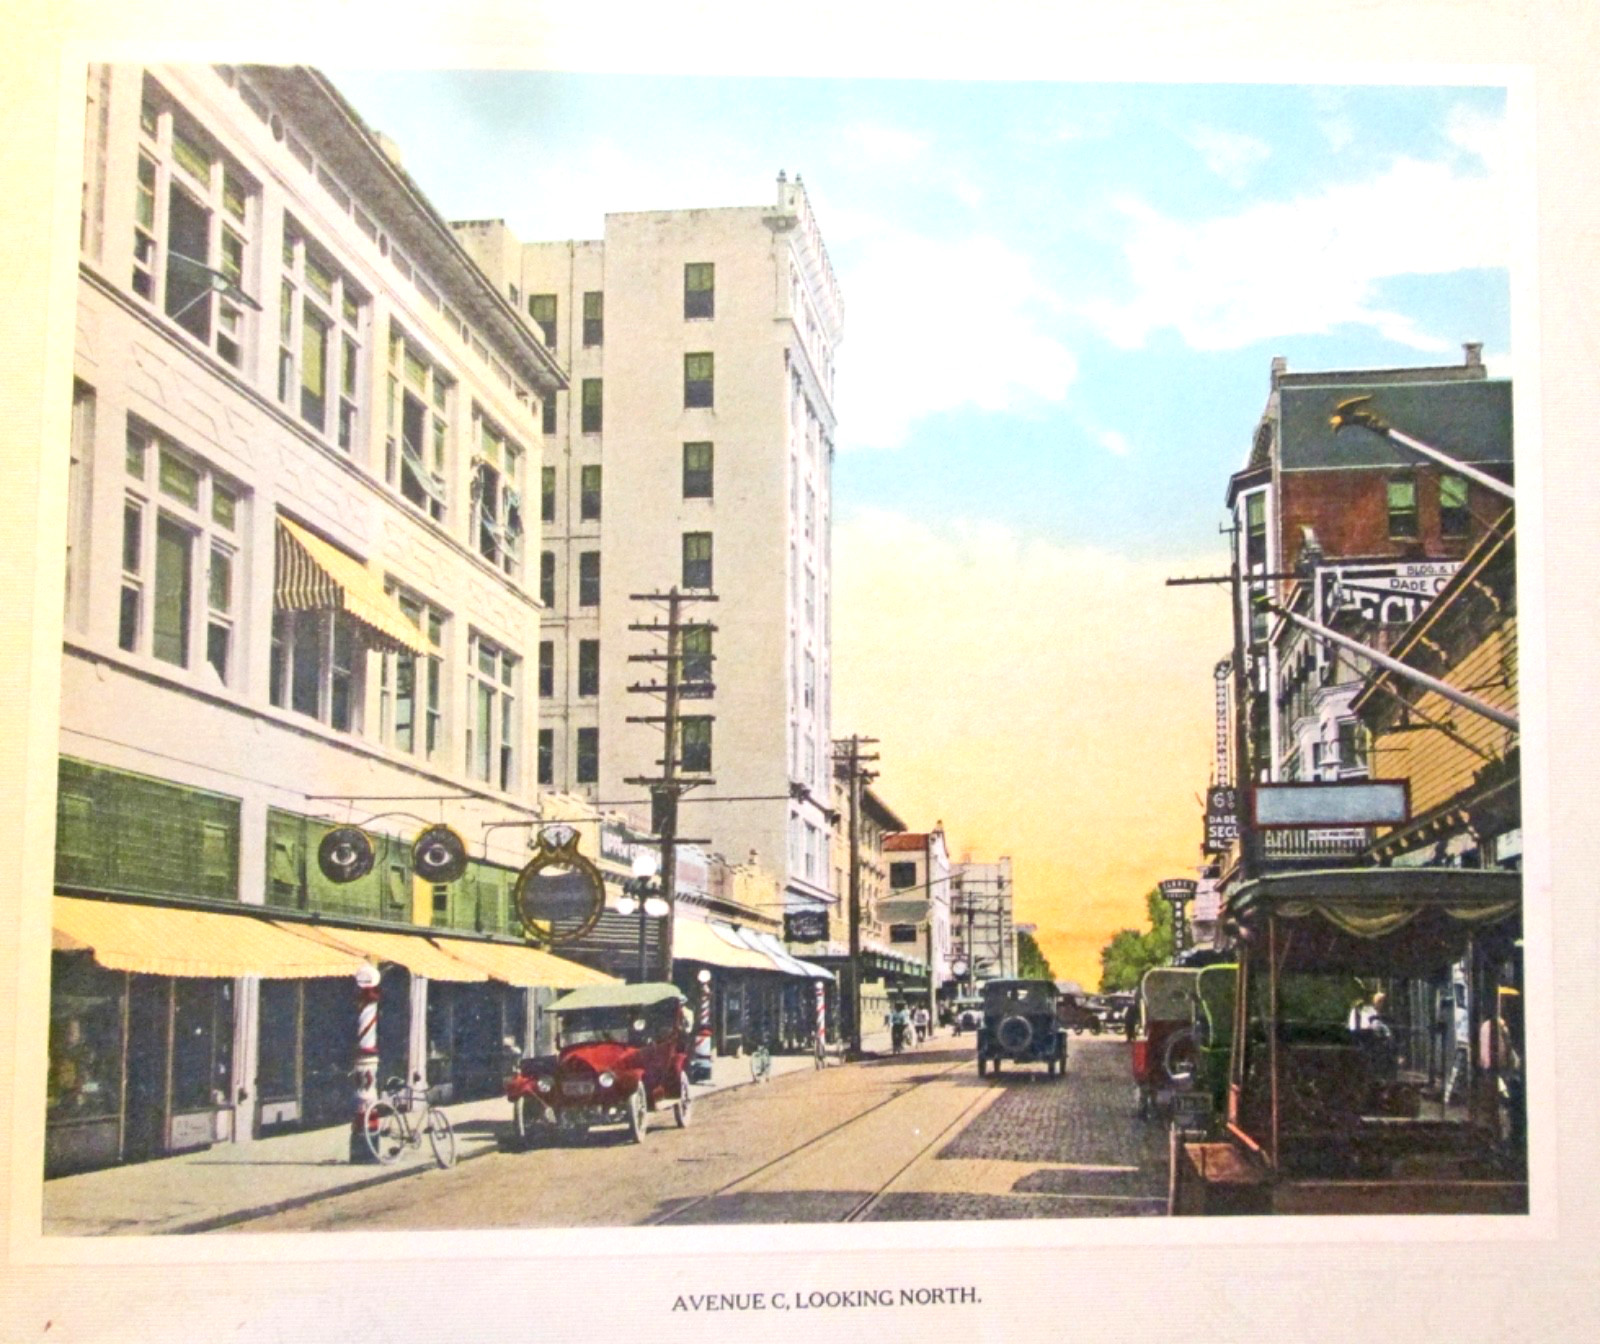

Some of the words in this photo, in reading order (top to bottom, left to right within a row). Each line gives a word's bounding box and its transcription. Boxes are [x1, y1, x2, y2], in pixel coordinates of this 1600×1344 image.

[1390, 579, 1428, 592] DADE
[672, 1293, 767, 1312] AVENUE
[771, 1292, 791, 1312] C,
[796, 1289, 895, 1310] LOOKING
[899, 1286, 983, 1306] NORTH.
